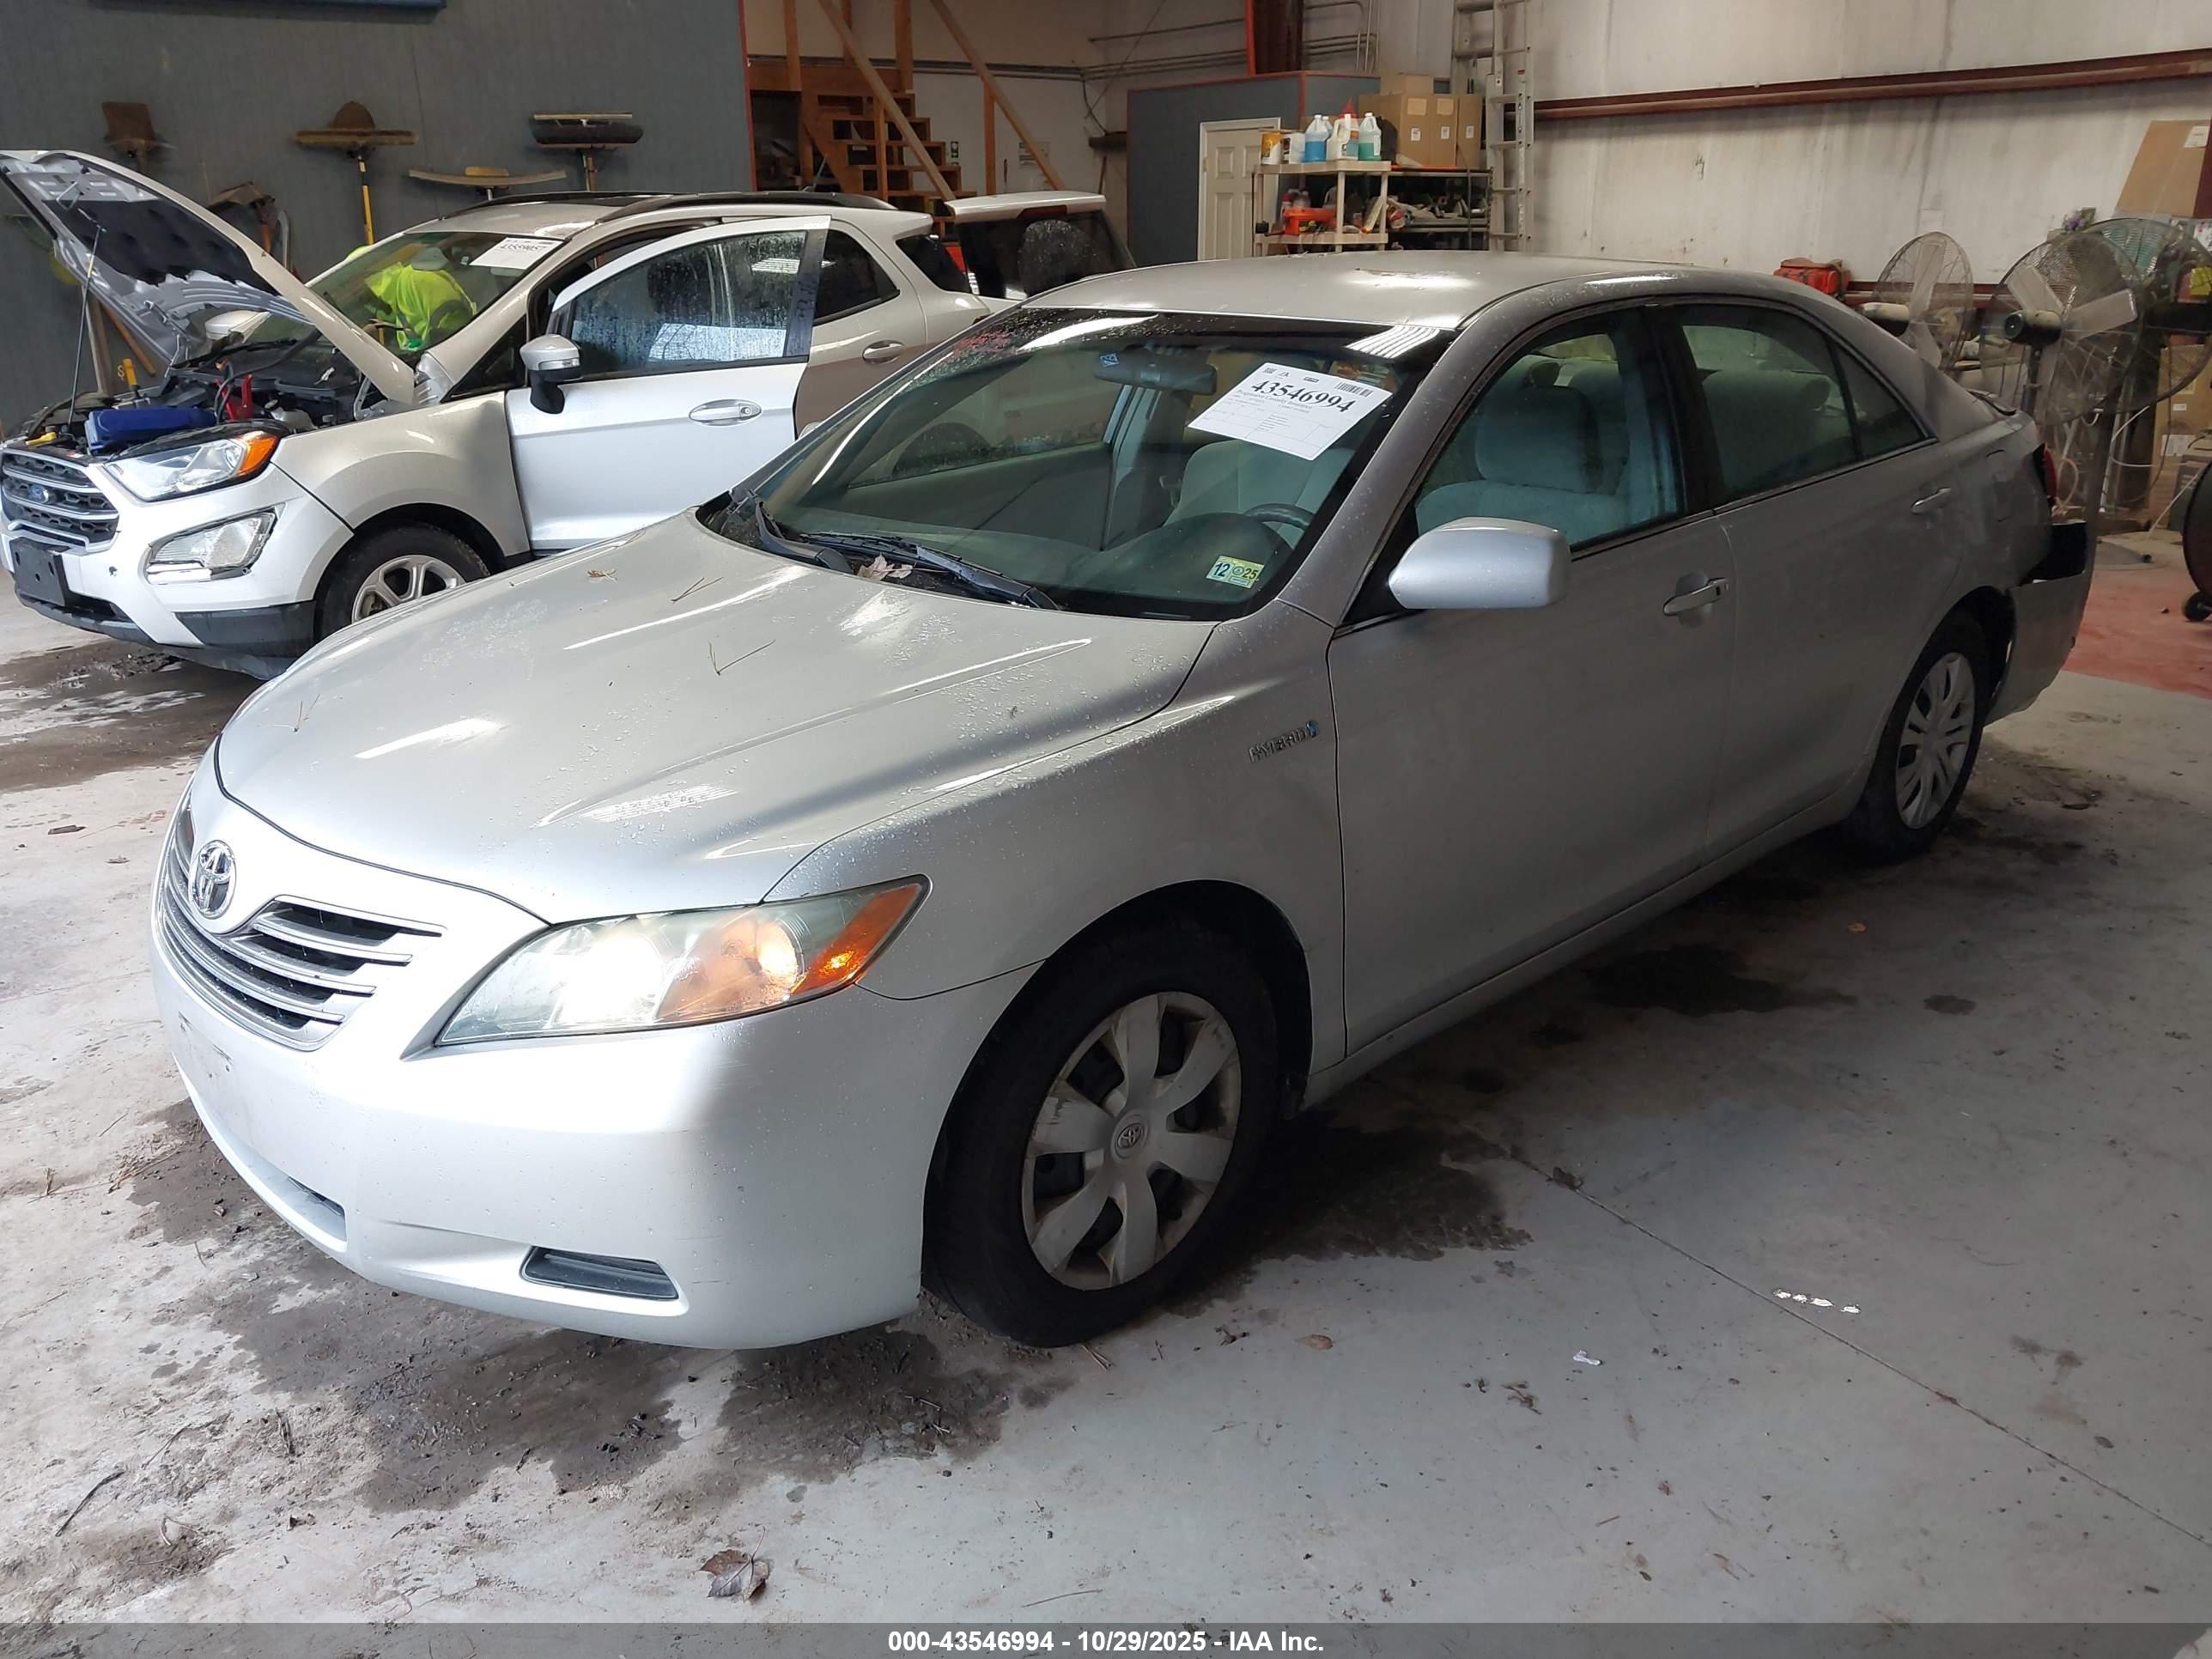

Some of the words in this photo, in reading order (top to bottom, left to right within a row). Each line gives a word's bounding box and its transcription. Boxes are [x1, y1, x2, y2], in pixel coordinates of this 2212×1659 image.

[1251, 380, 1357, 413] 43546994
[1213, 562, 1231, 577] 12
[1242, 568, 1259, 580] 25
